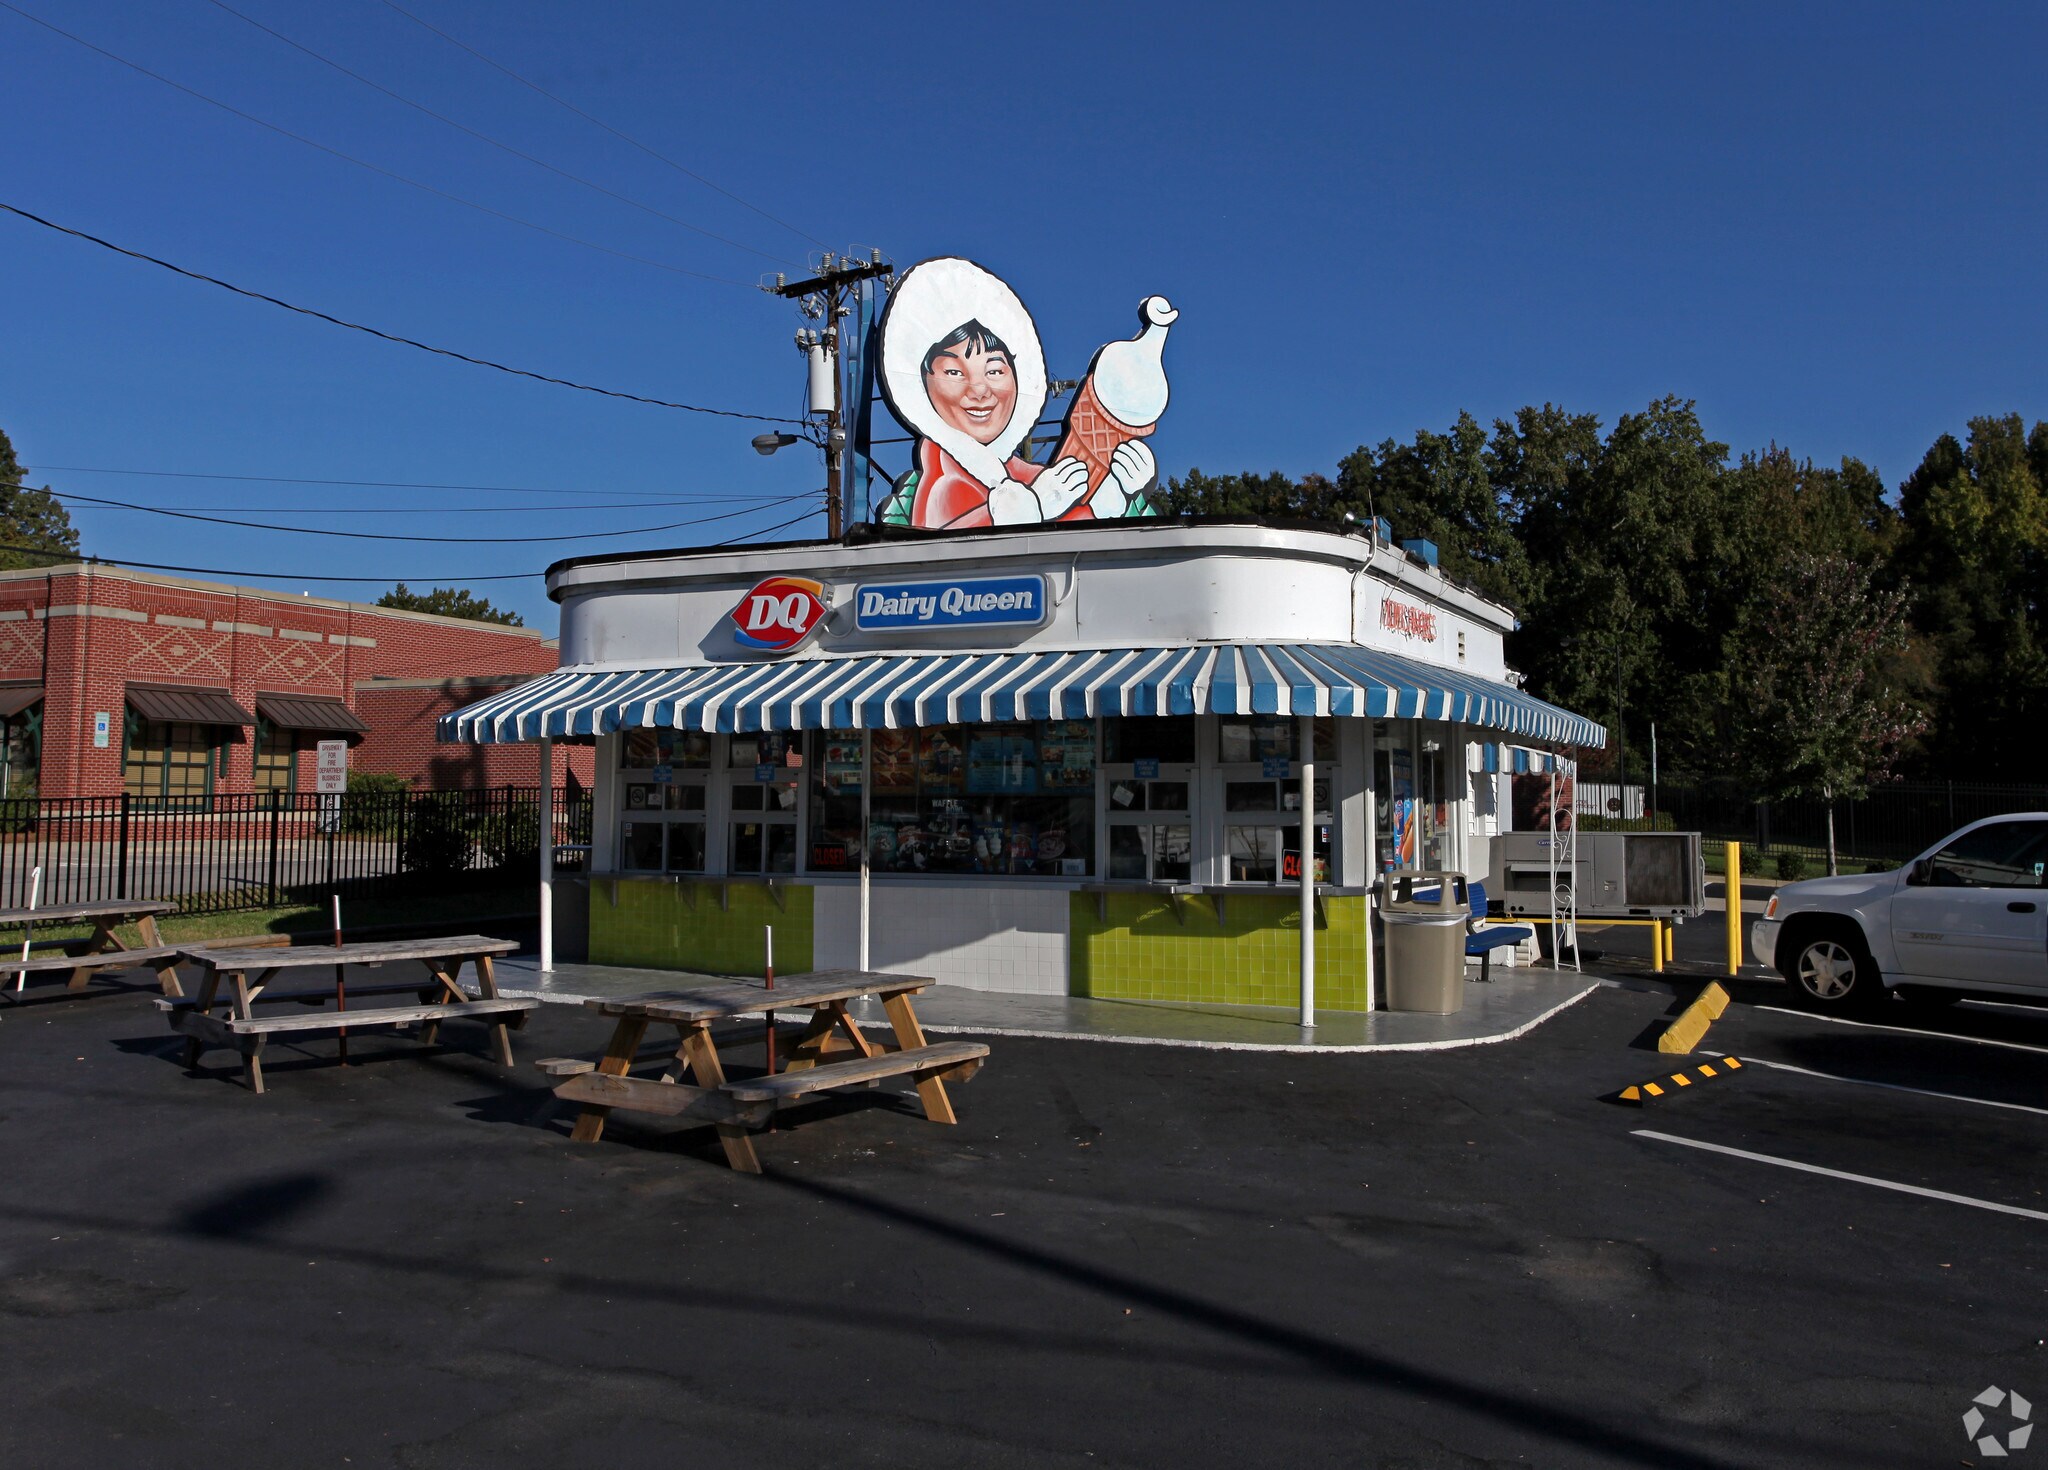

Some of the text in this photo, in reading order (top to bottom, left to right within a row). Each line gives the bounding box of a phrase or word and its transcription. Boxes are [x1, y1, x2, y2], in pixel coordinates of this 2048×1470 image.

[746, 592, 811, 634] DQ
[860, 587, 1033, 620] Dairy Queen
[932, 799, 959, 808] WAFFLE
[814, 847, 845, 866] CLOSED
